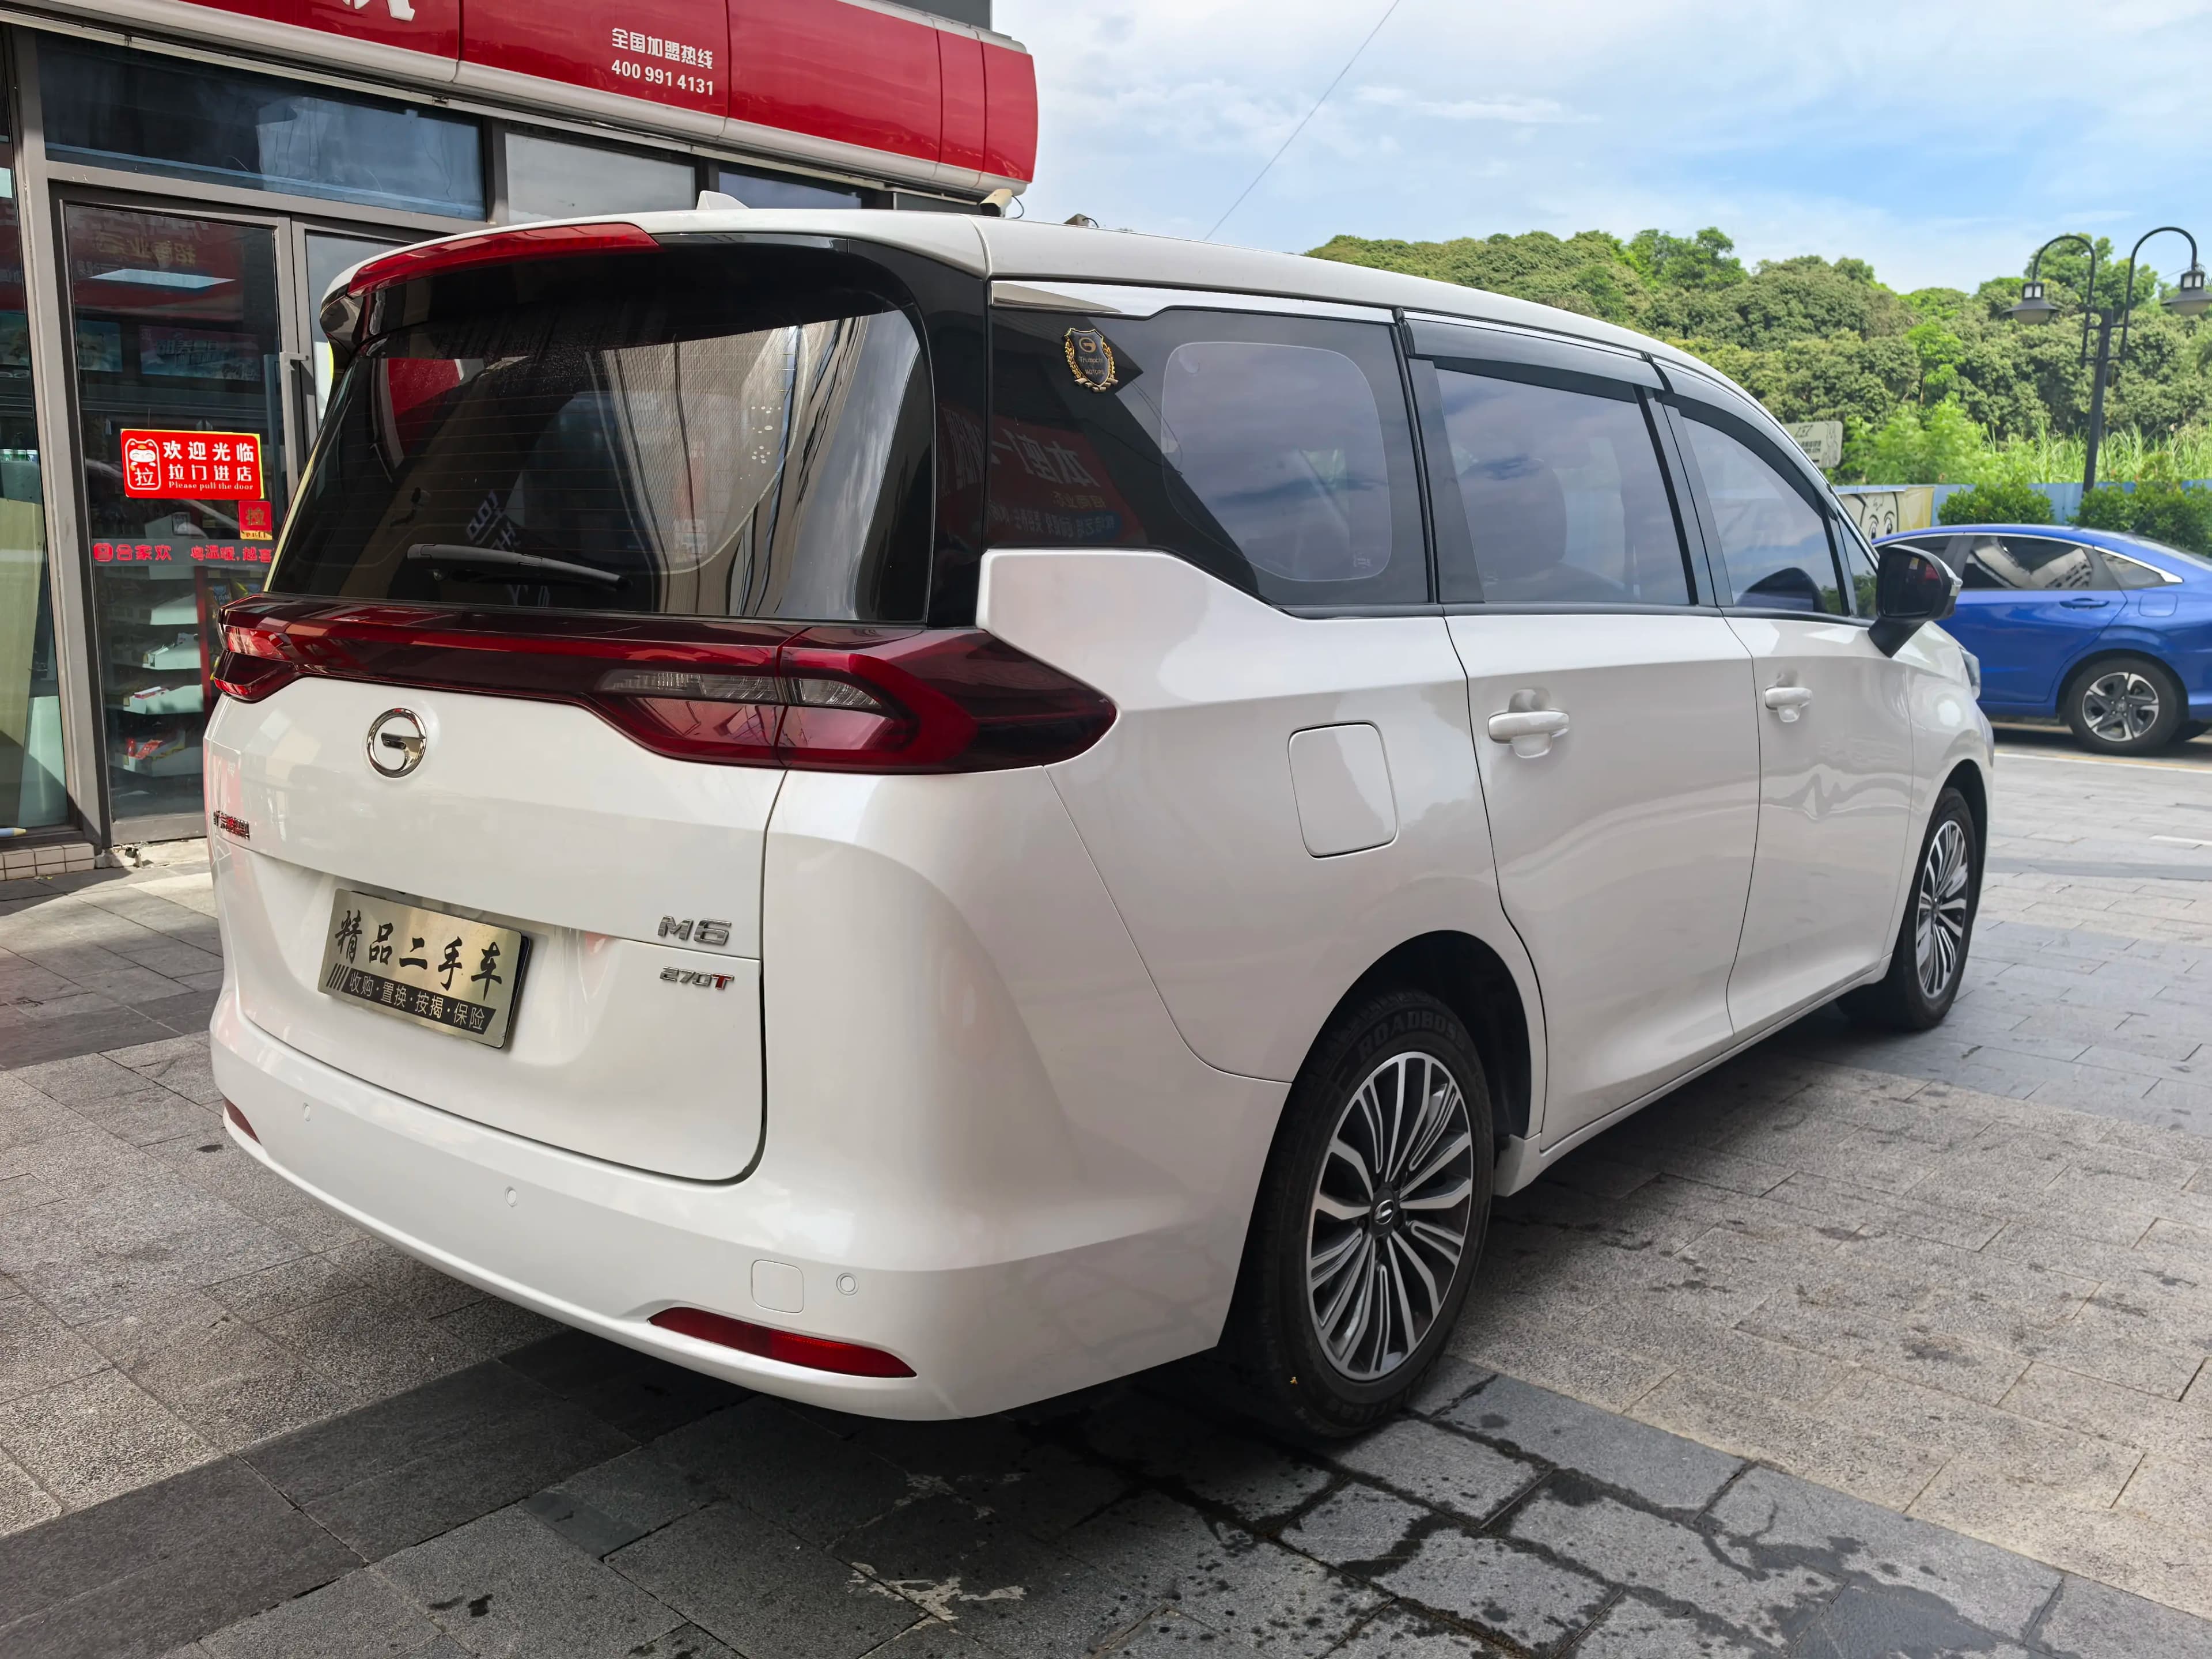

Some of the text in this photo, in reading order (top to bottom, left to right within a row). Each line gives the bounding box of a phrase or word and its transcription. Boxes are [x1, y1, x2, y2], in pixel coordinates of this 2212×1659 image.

[612, 28, 713, 70] 全国加盟热线
[611, 59, 713, 96] 400 991 4131
[162, 440, 254, 462] 欢迎光临
[134, 467, 156, 486] 拉
[168, 464, 252, 482] 拉门进店
[199, 482, 216, 491] pull
[245, 507, 266, 525] 拉
[191, 544, 273, 563] 粤温暖，越喜
[658, 915, 732, 945] M6
[335, 910, 502, 1001] 精品二手车
[660, 966, 734, 990] 270T
